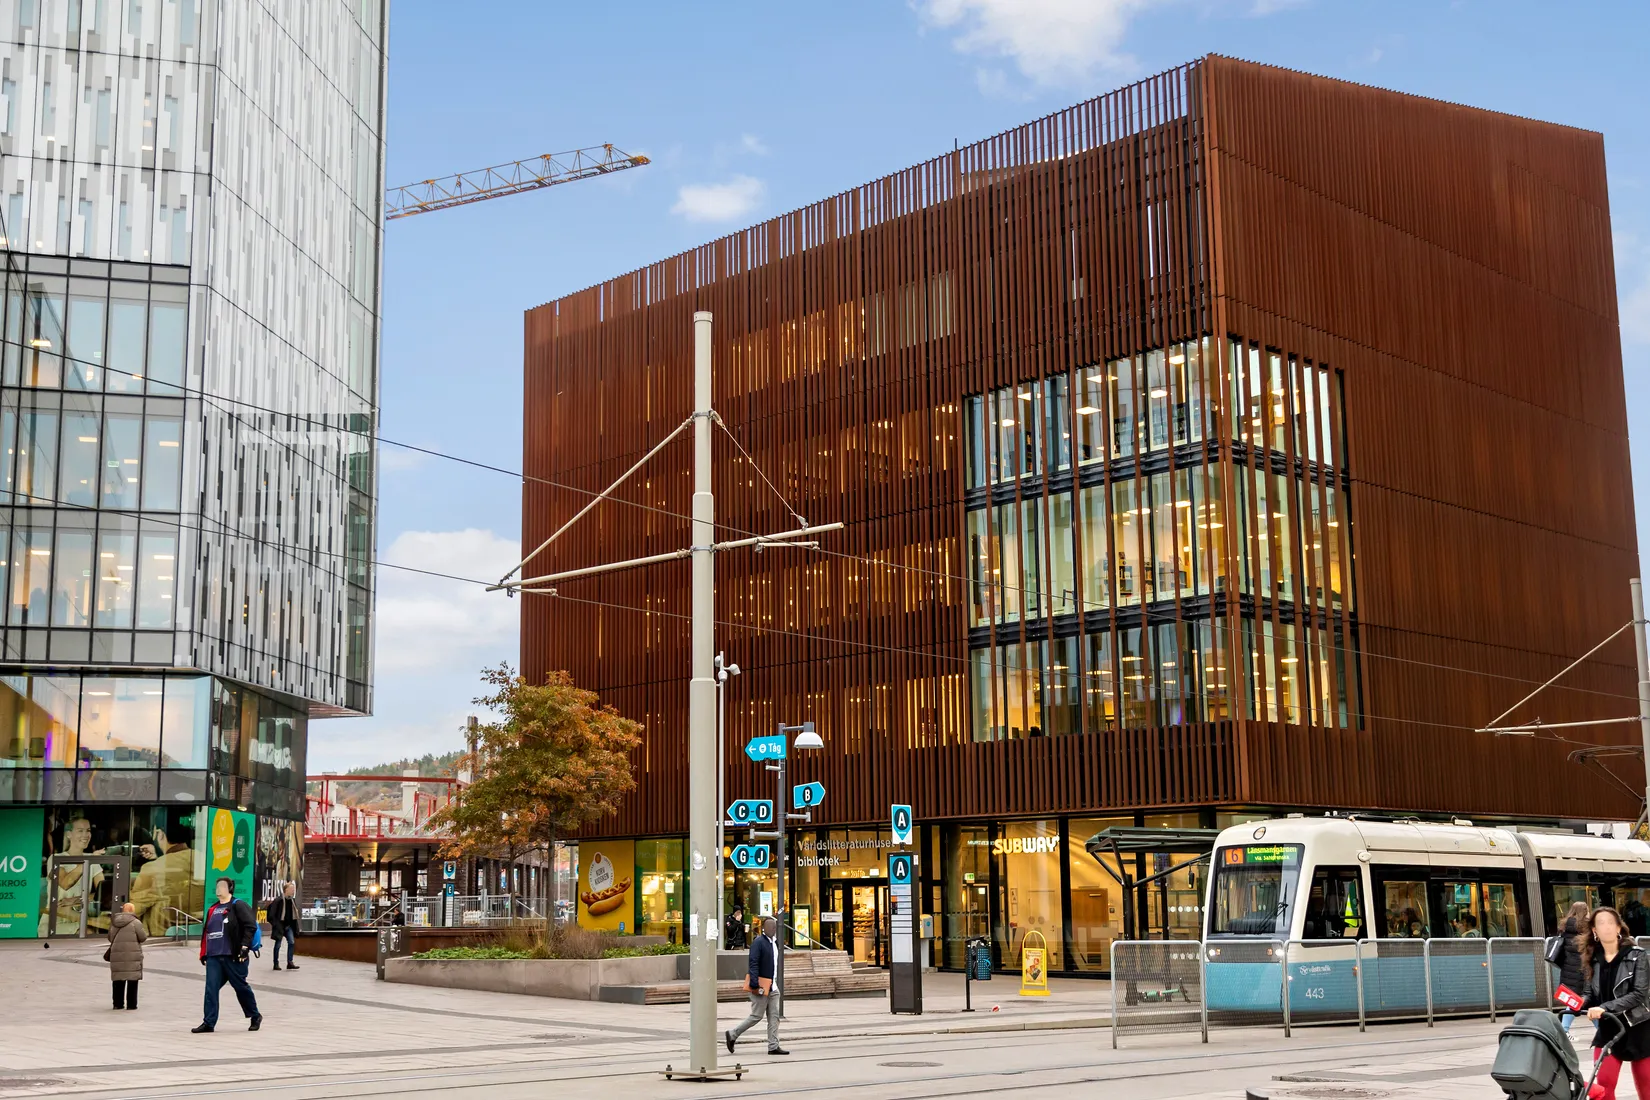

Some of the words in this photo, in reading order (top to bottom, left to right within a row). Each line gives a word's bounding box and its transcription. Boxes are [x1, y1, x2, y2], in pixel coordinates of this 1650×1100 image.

[768, 742, 782, 753] Tåg
[804, 789, 811, 801] B
[738, 805, 746, 817] C
[759, 805, 767, 817] D
[897, 812, 906, 827] A
[992, 834, 1060, 856] SUBWAY
[740, 850, 747, 862] G
[757, 850, 764, 862] J
[797, 855, 840, 867] bibliotek
[1231, 848, 1239, 862] 6
[447, 864, 452, 872] E
[896, 861, 906, 877] A
[448, 886, 452, 894] E
[1305, 987, 1325, 999] 443
